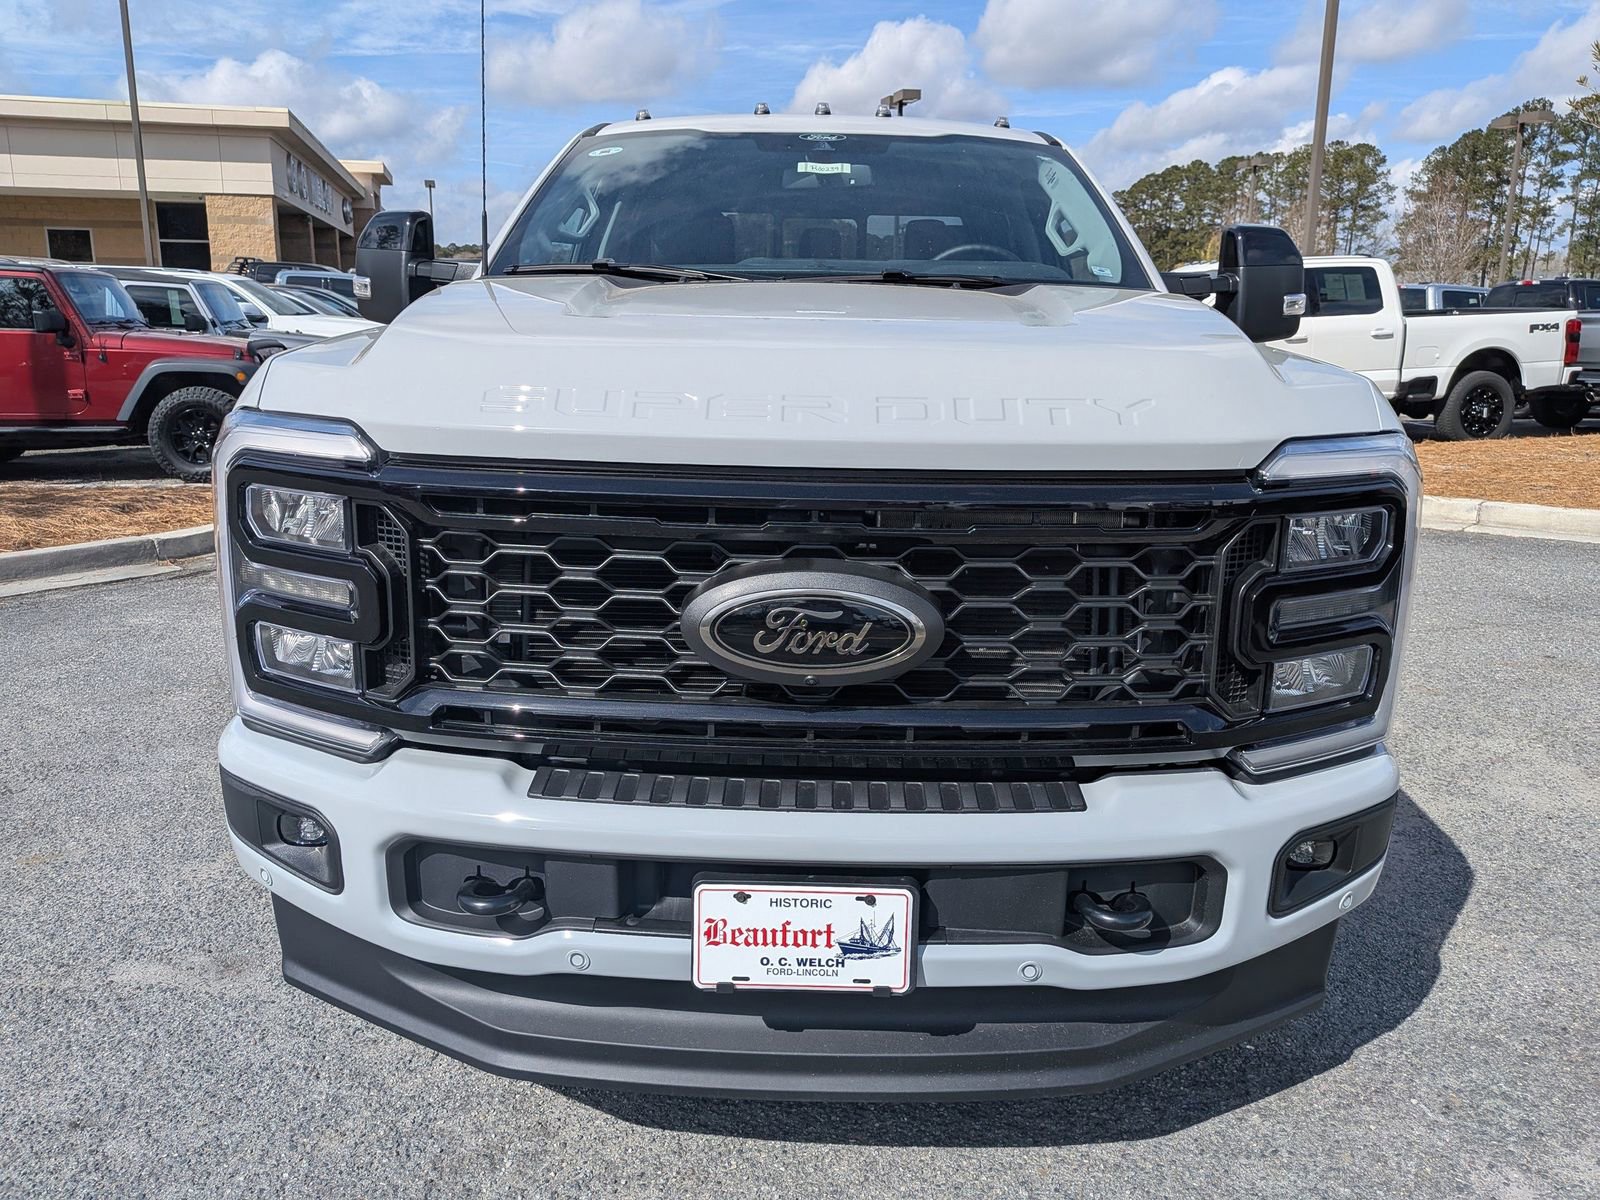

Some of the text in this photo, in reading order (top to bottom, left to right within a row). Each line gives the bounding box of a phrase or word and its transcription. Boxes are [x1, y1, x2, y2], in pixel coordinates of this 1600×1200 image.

[1529, 323, 1559, 333] FX4
[480, 386, 1157, 426] SUPER DUTY
[753, 607, 873, 656] Ford
[769, 897, 833, 909] HISTORIC
[703, 917, 836, 949] Beaufort
[760, 957, 845, 968] O. C. WELCH
[766, 967, 839, 977] FORD-LINCOLN
